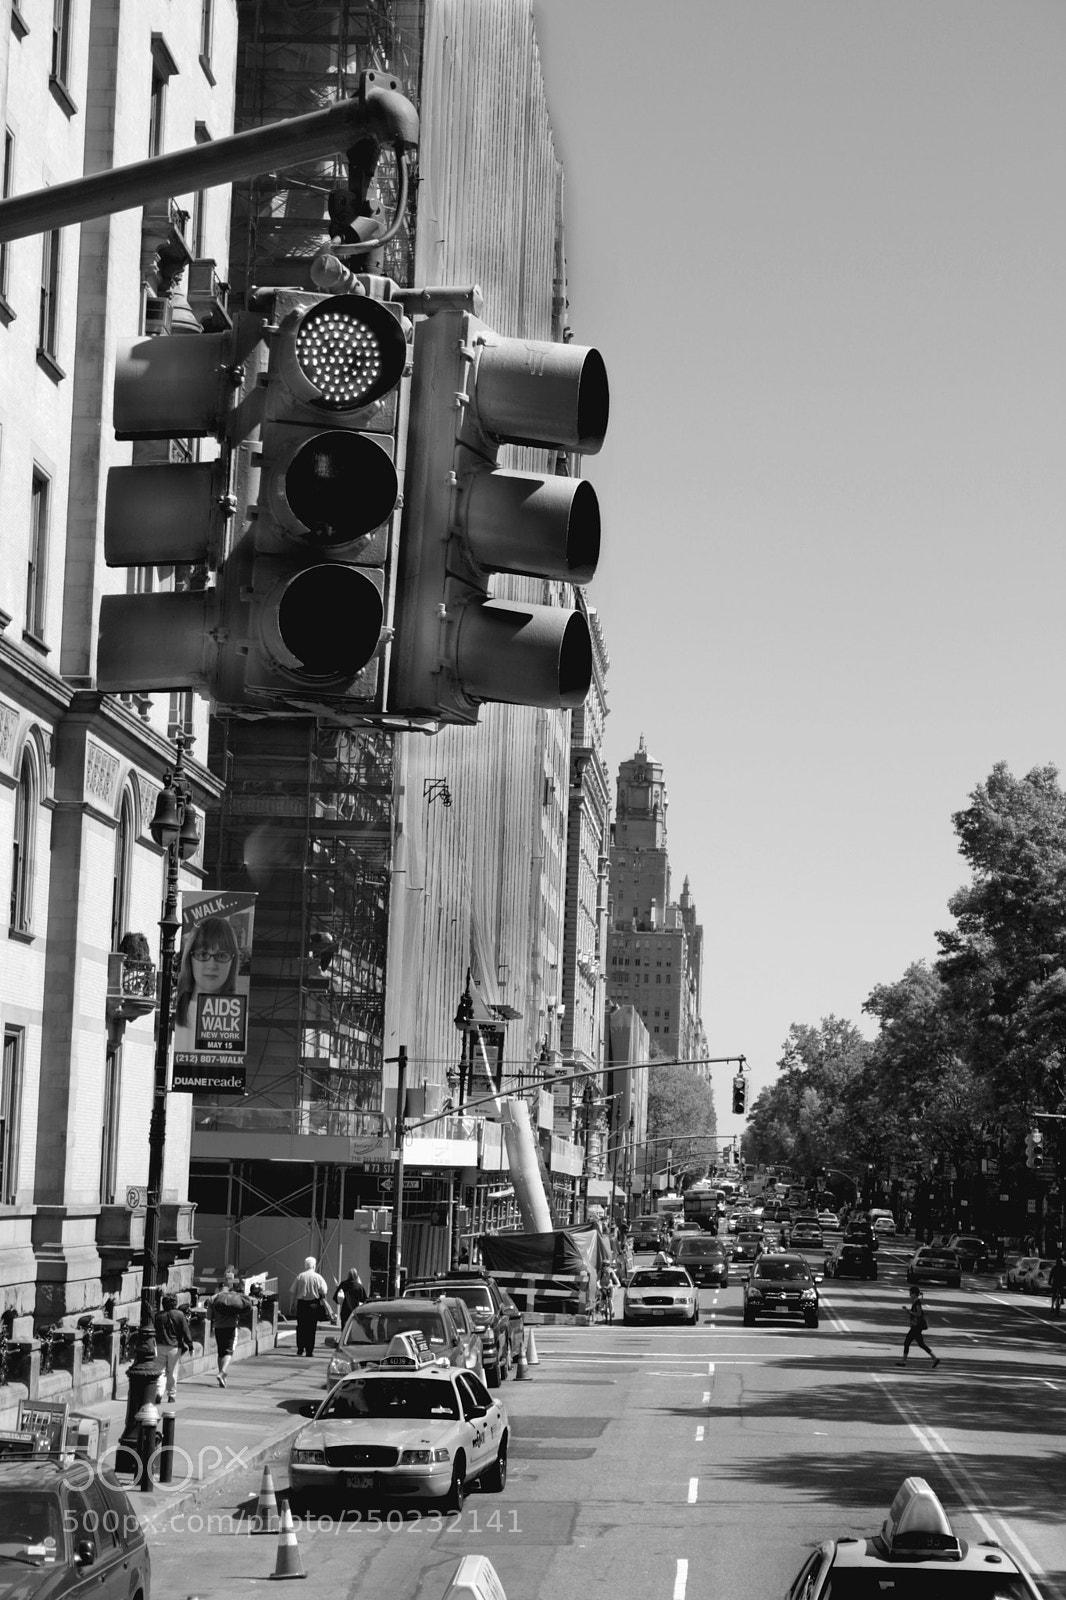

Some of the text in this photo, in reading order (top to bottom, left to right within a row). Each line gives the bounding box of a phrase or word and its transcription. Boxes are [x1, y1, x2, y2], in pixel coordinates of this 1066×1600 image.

[183, 911, 190, 924] I
[202, 998, 241, 1017] AIDS
[201, 1017, 240, 1032] WALK
[200, 1031, 240, 1040] NEW YORK
[207, 1041, 233, 1050] MAY 15
[175, 1054, 244, 1065] (212) 807-WALK
[364, 1163, 370, 1173] W
[371, 1163, 380, 1173] 73
